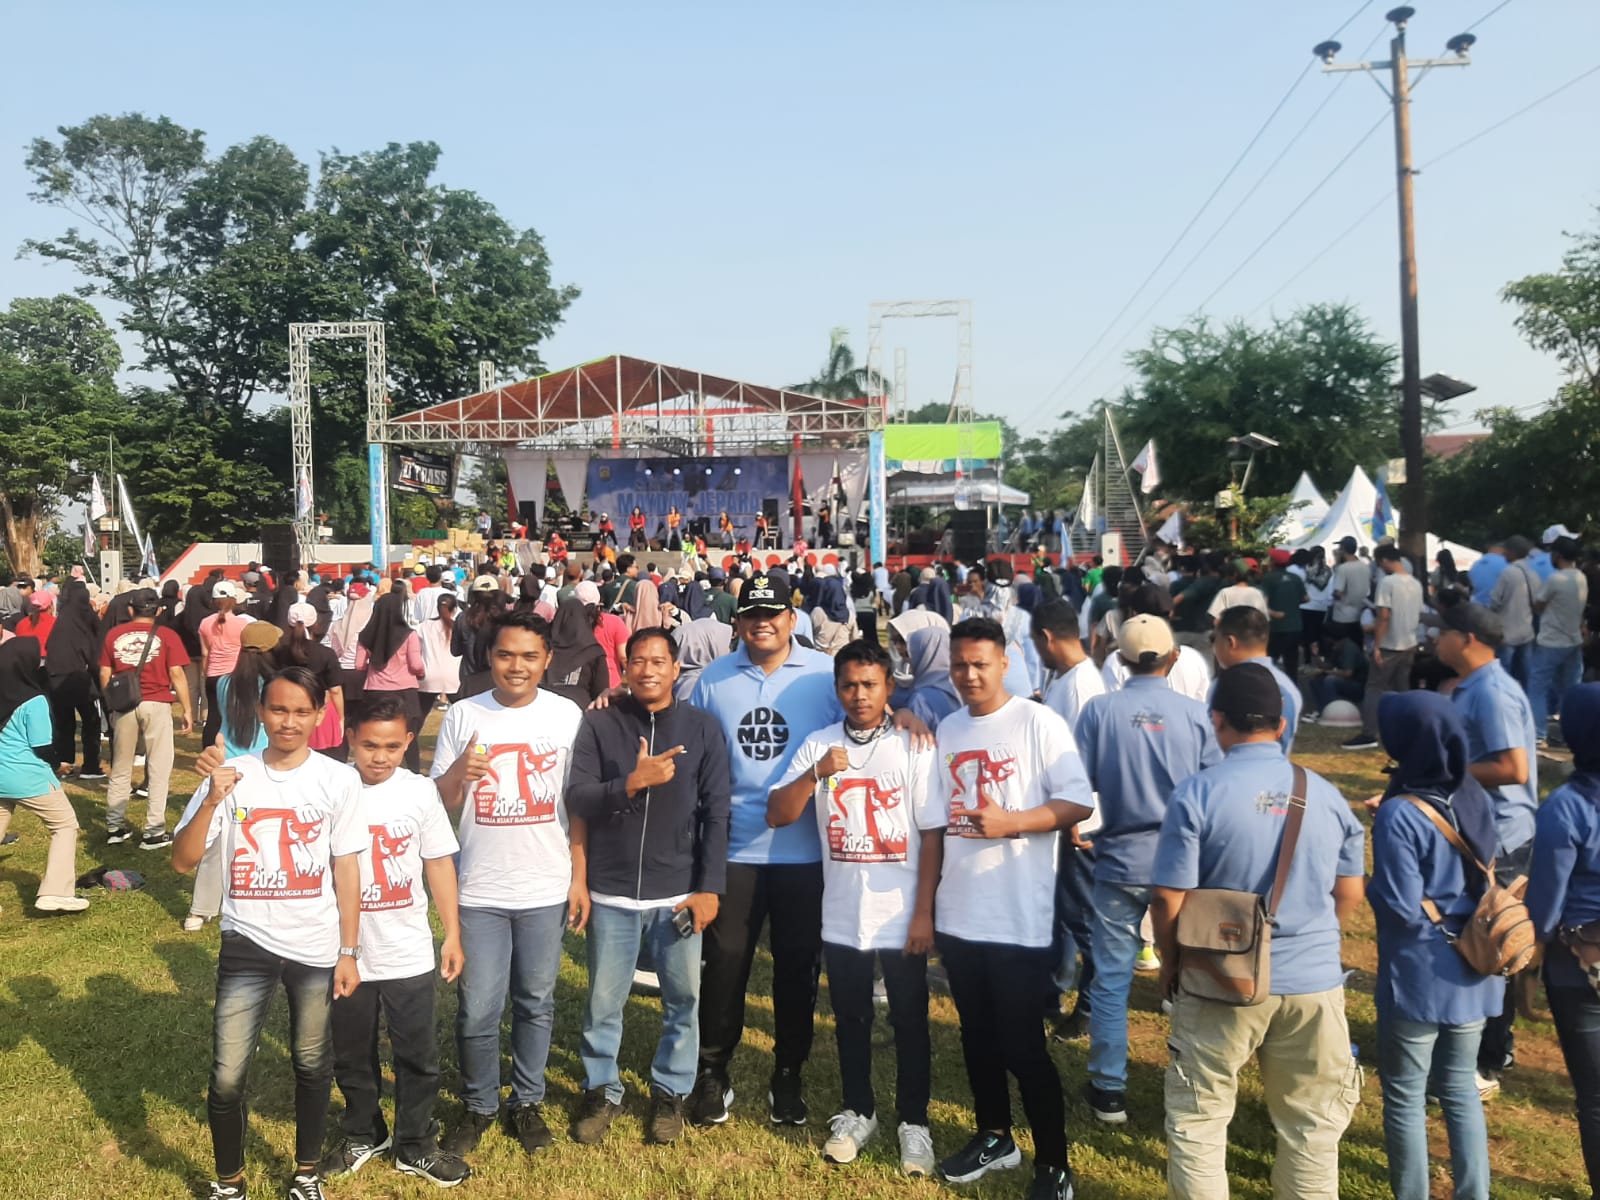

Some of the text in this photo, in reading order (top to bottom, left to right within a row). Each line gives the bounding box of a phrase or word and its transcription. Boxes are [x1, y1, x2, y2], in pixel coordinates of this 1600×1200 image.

[617, 491, 761, 516] MAYDAY JEPARA
[492, 798, 527, 817] 2025
[842, 835, 875, 853] 2025
[249, 870, 288, 889] 2025
